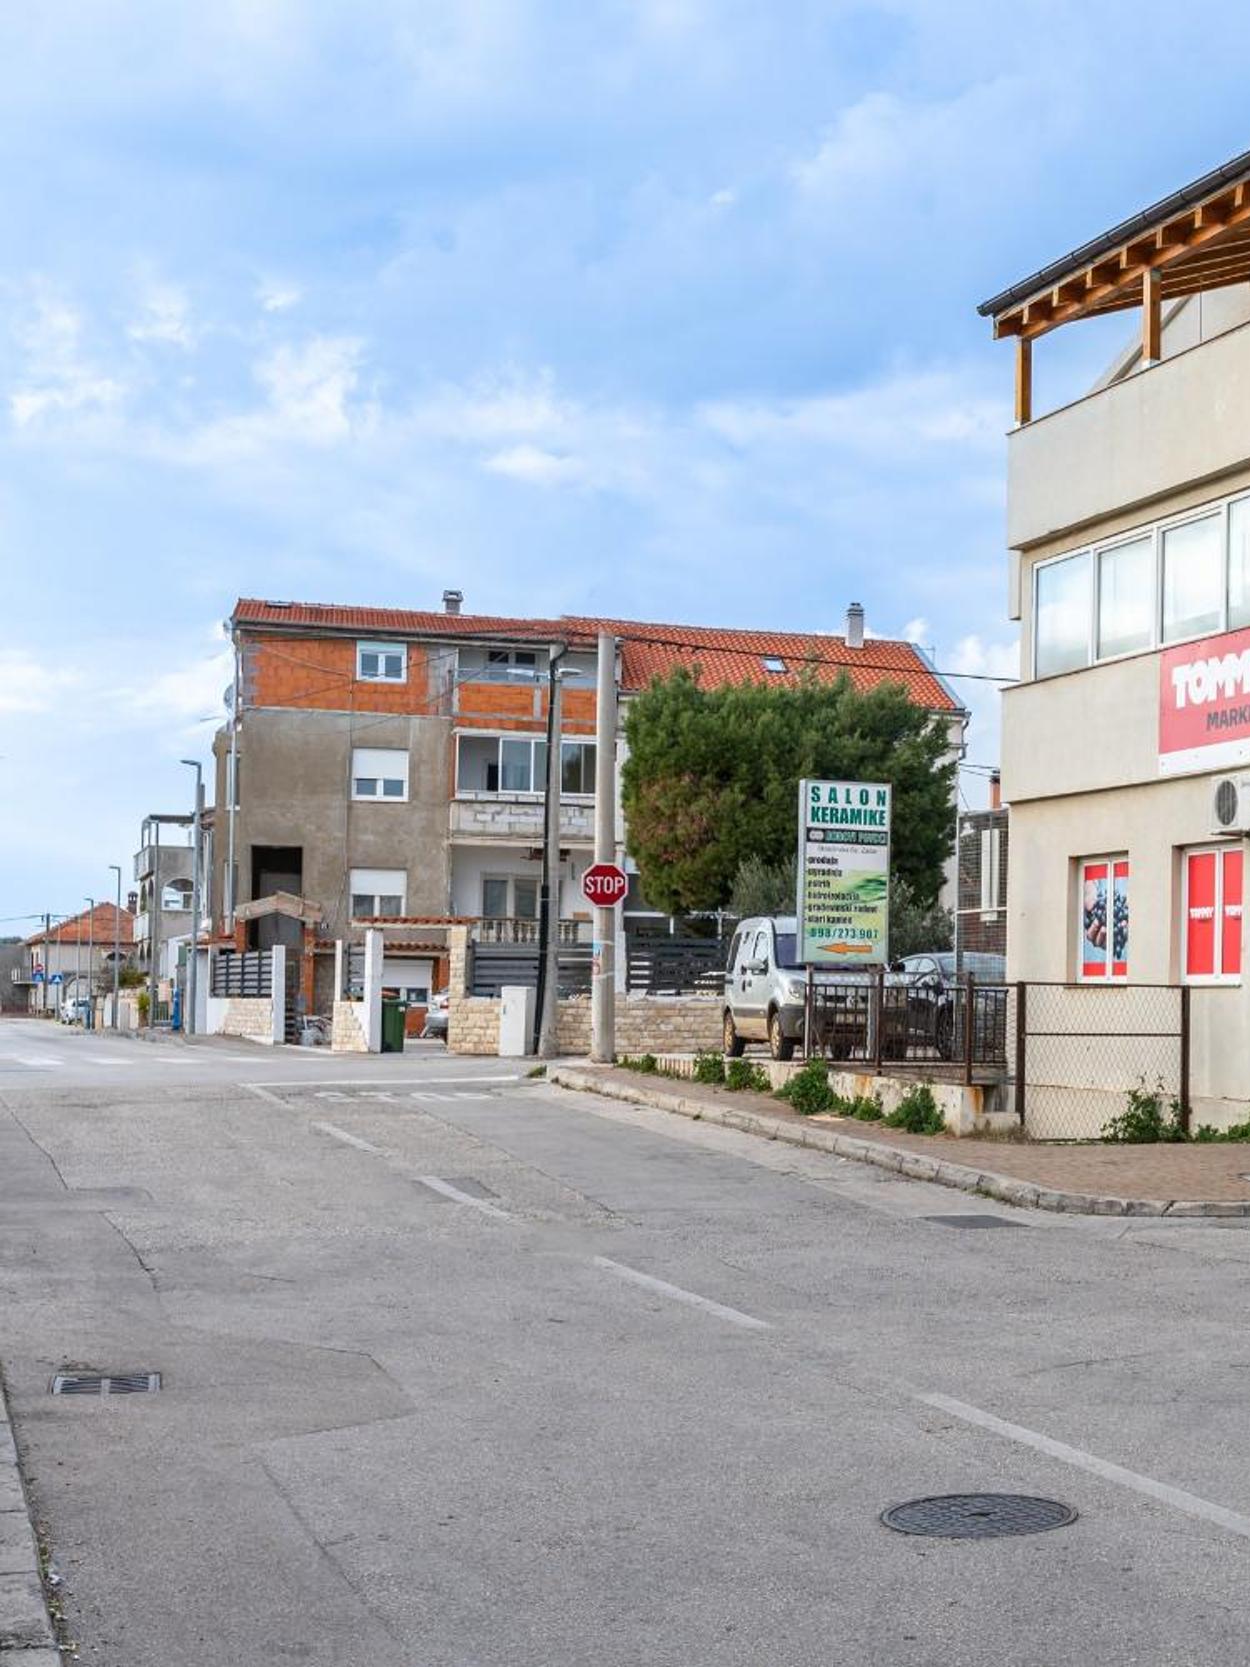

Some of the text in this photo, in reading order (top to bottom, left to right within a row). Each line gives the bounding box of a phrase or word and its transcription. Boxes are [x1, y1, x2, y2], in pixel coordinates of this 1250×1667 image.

[811, 785, 887, 807] SALON
[811, 806, 886, 826] KERAMIKE
[585, 876, 624, 894] STOP
